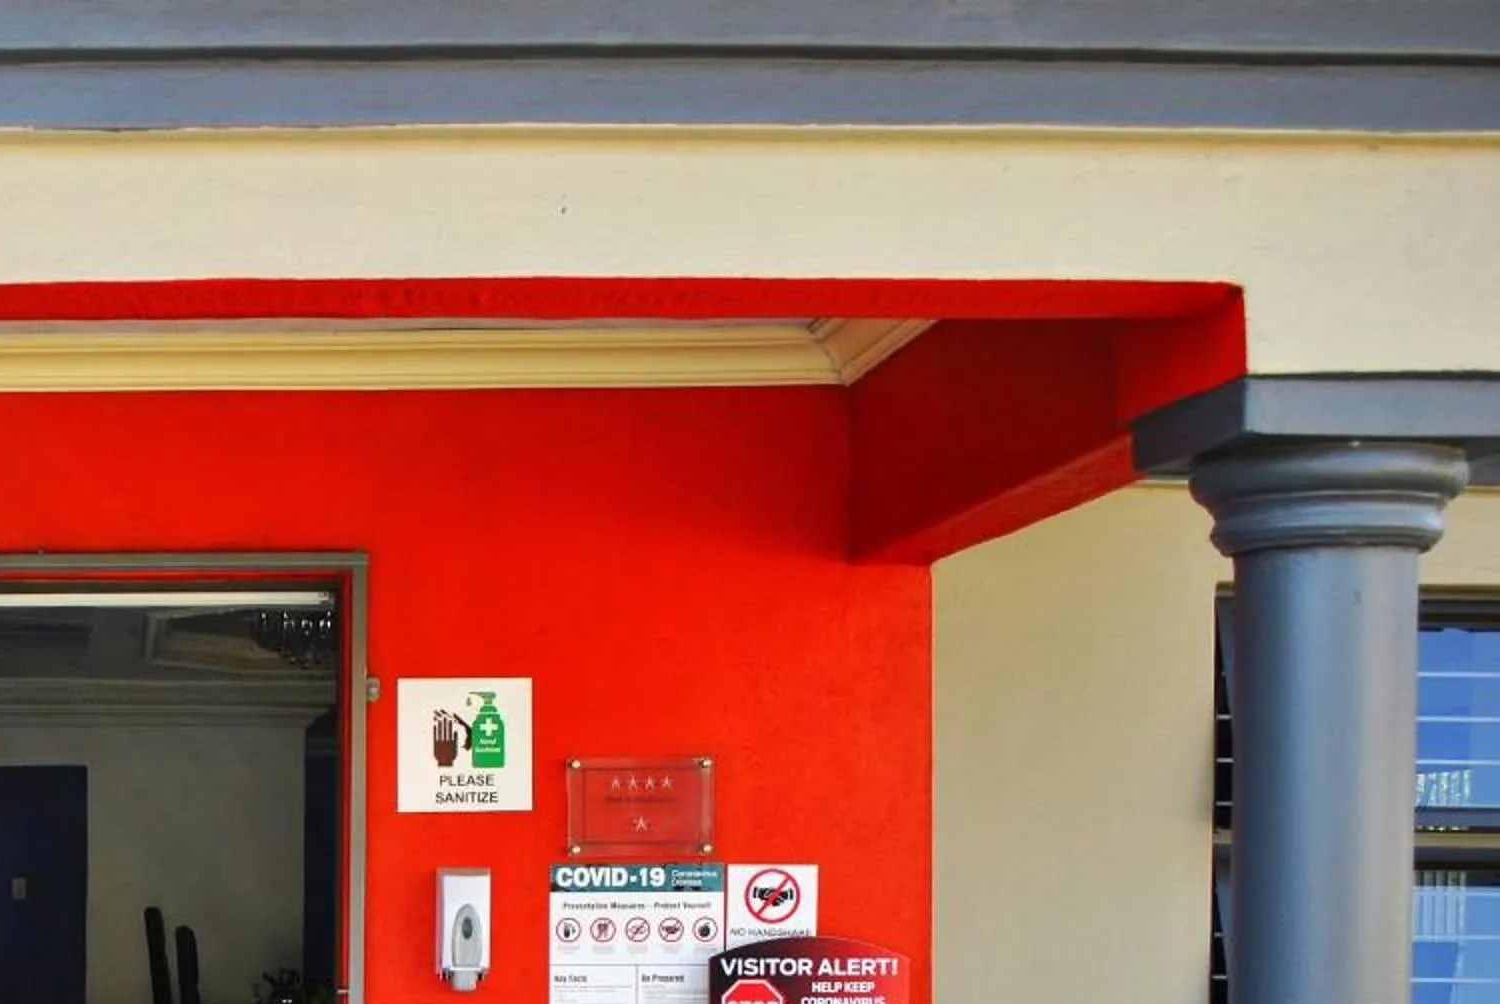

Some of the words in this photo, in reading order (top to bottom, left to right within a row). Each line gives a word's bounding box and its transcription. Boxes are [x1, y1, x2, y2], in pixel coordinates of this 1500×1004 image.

[439, 773, 495, 787] PLEASE
[435, 790, 499, 804] SANITIZE
[555, 866, 665, 888] COVID-19
[730, 927, 746, 937] NO
[720, 958, 813, 976] VISITOR
[817, 958, 899, 976] ALERT!
[811, 981, 842, 993] HELP
[844, 981, 875, 993] KEEP
